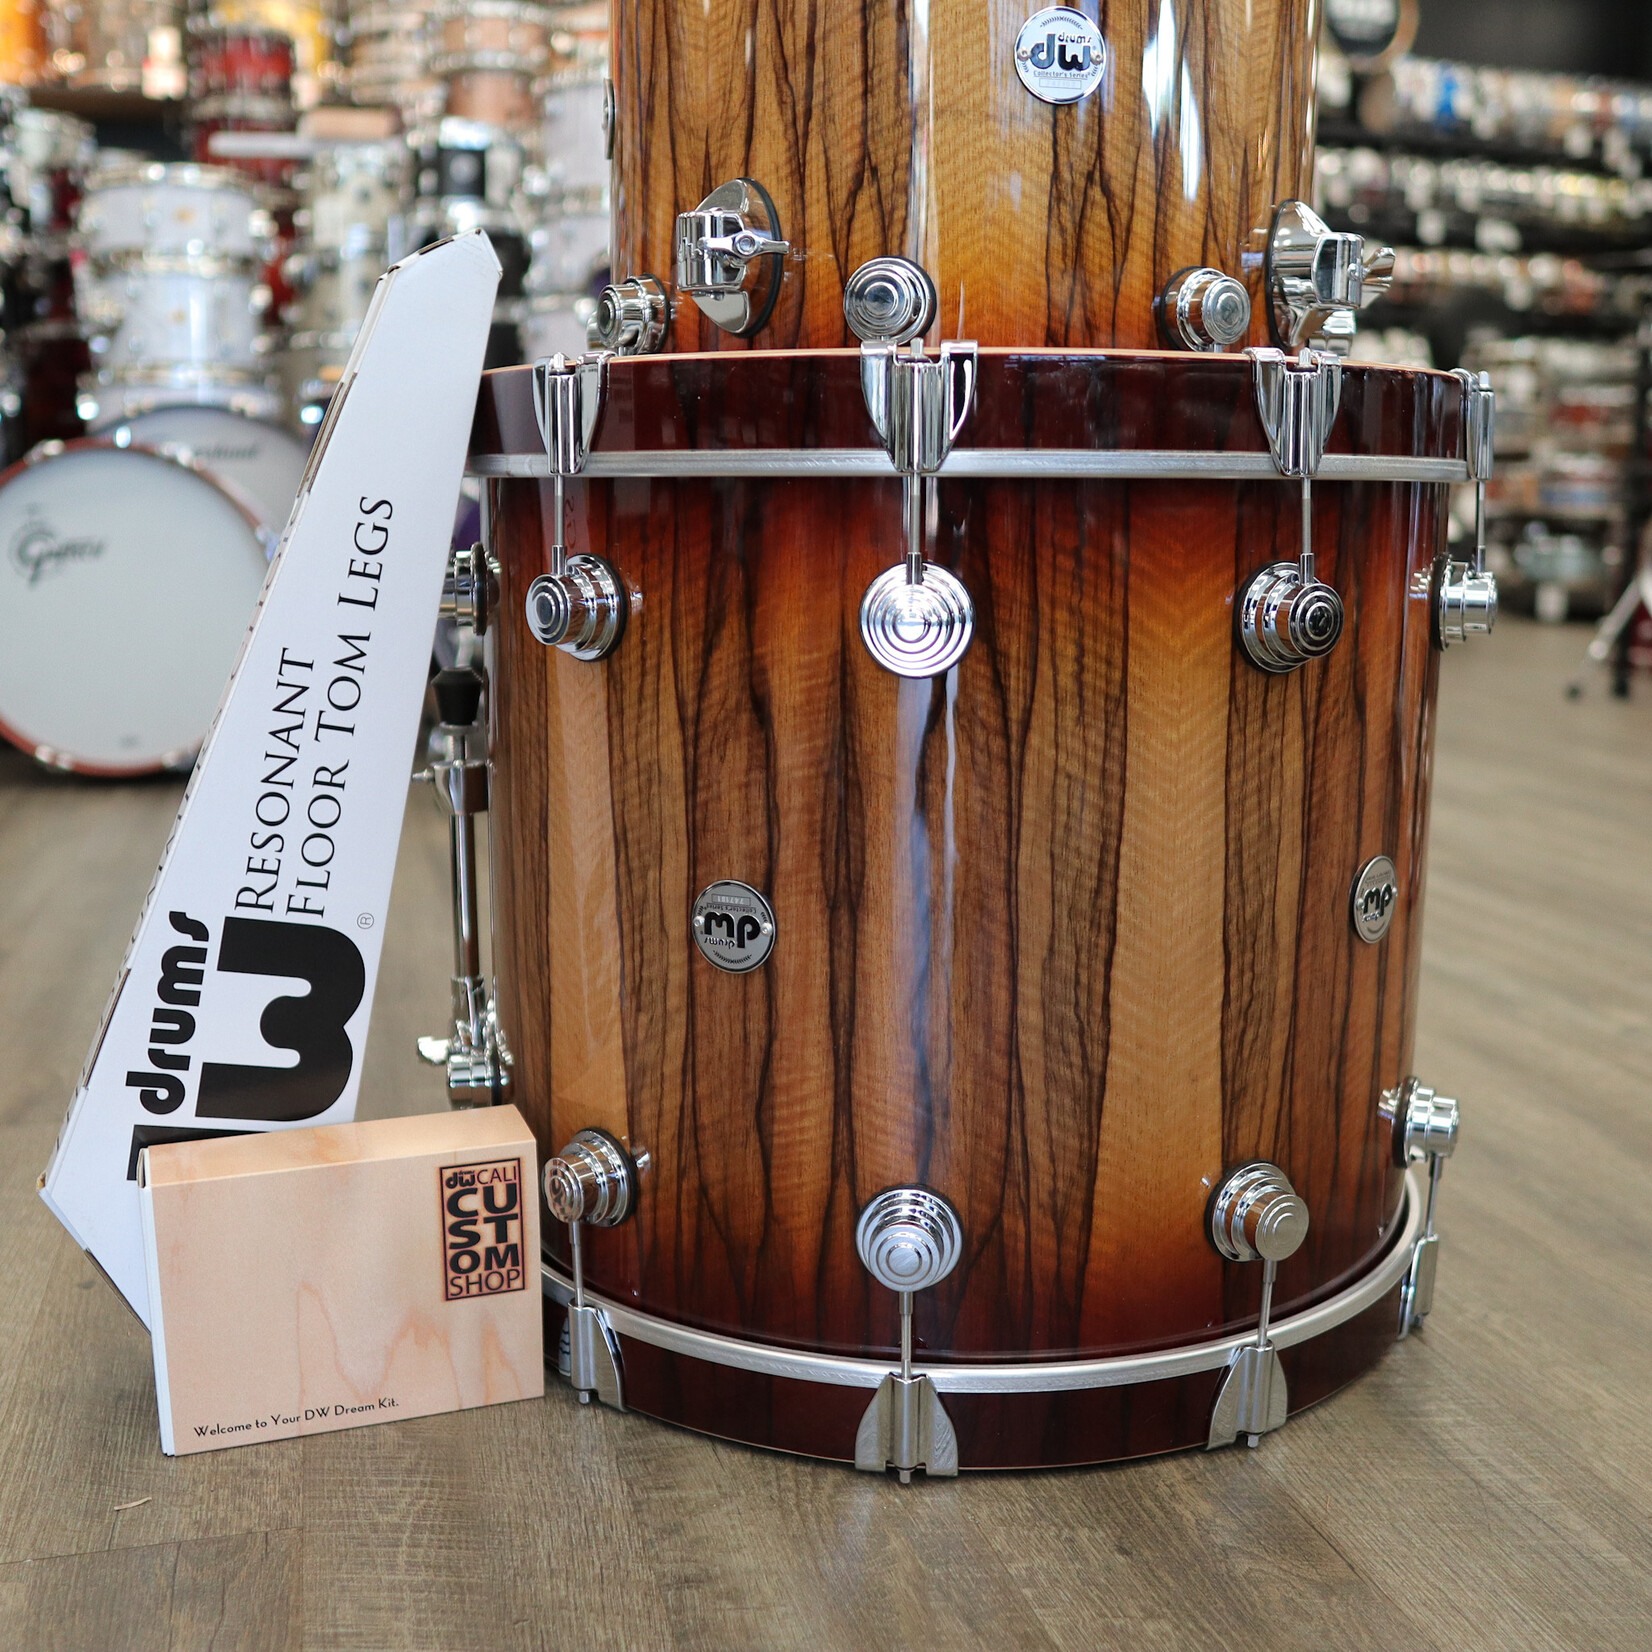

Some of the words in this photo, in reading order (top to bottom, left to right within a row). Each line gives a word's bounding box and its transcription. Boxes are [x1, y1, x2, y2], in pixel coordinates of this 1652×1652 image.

[1030, 33, 1091, 71] dw
[1058, 32, 1092, 44] drums
[1033, 70, 1067, 78] Collector's
[337, 496, 393, 612] LEGS
[314, 631, 372, 743] TOM
[234, 648, 314, 913] RESONANT
[286, 759, 349, 918] FLOOR
[704, 911, 761, 949] dw
[704, 937, 735, 949] drums
[125, 911, 209, 1115] drums
[445, 1172, 475, 1189] dw
[477, 1166, 517, 1185] CALI
[450, 1269, 520, 1296] SHOP
[194, 1422, 252, 1437] Welcome
[255, 1419, 268, 1429] to
[270, 1414, 300, 1426] Your
[304, 1406, 331, 1421] DW
[334, 1403, 375, 1416] Dream
[378, 1397, 399, 1409] Kit.
